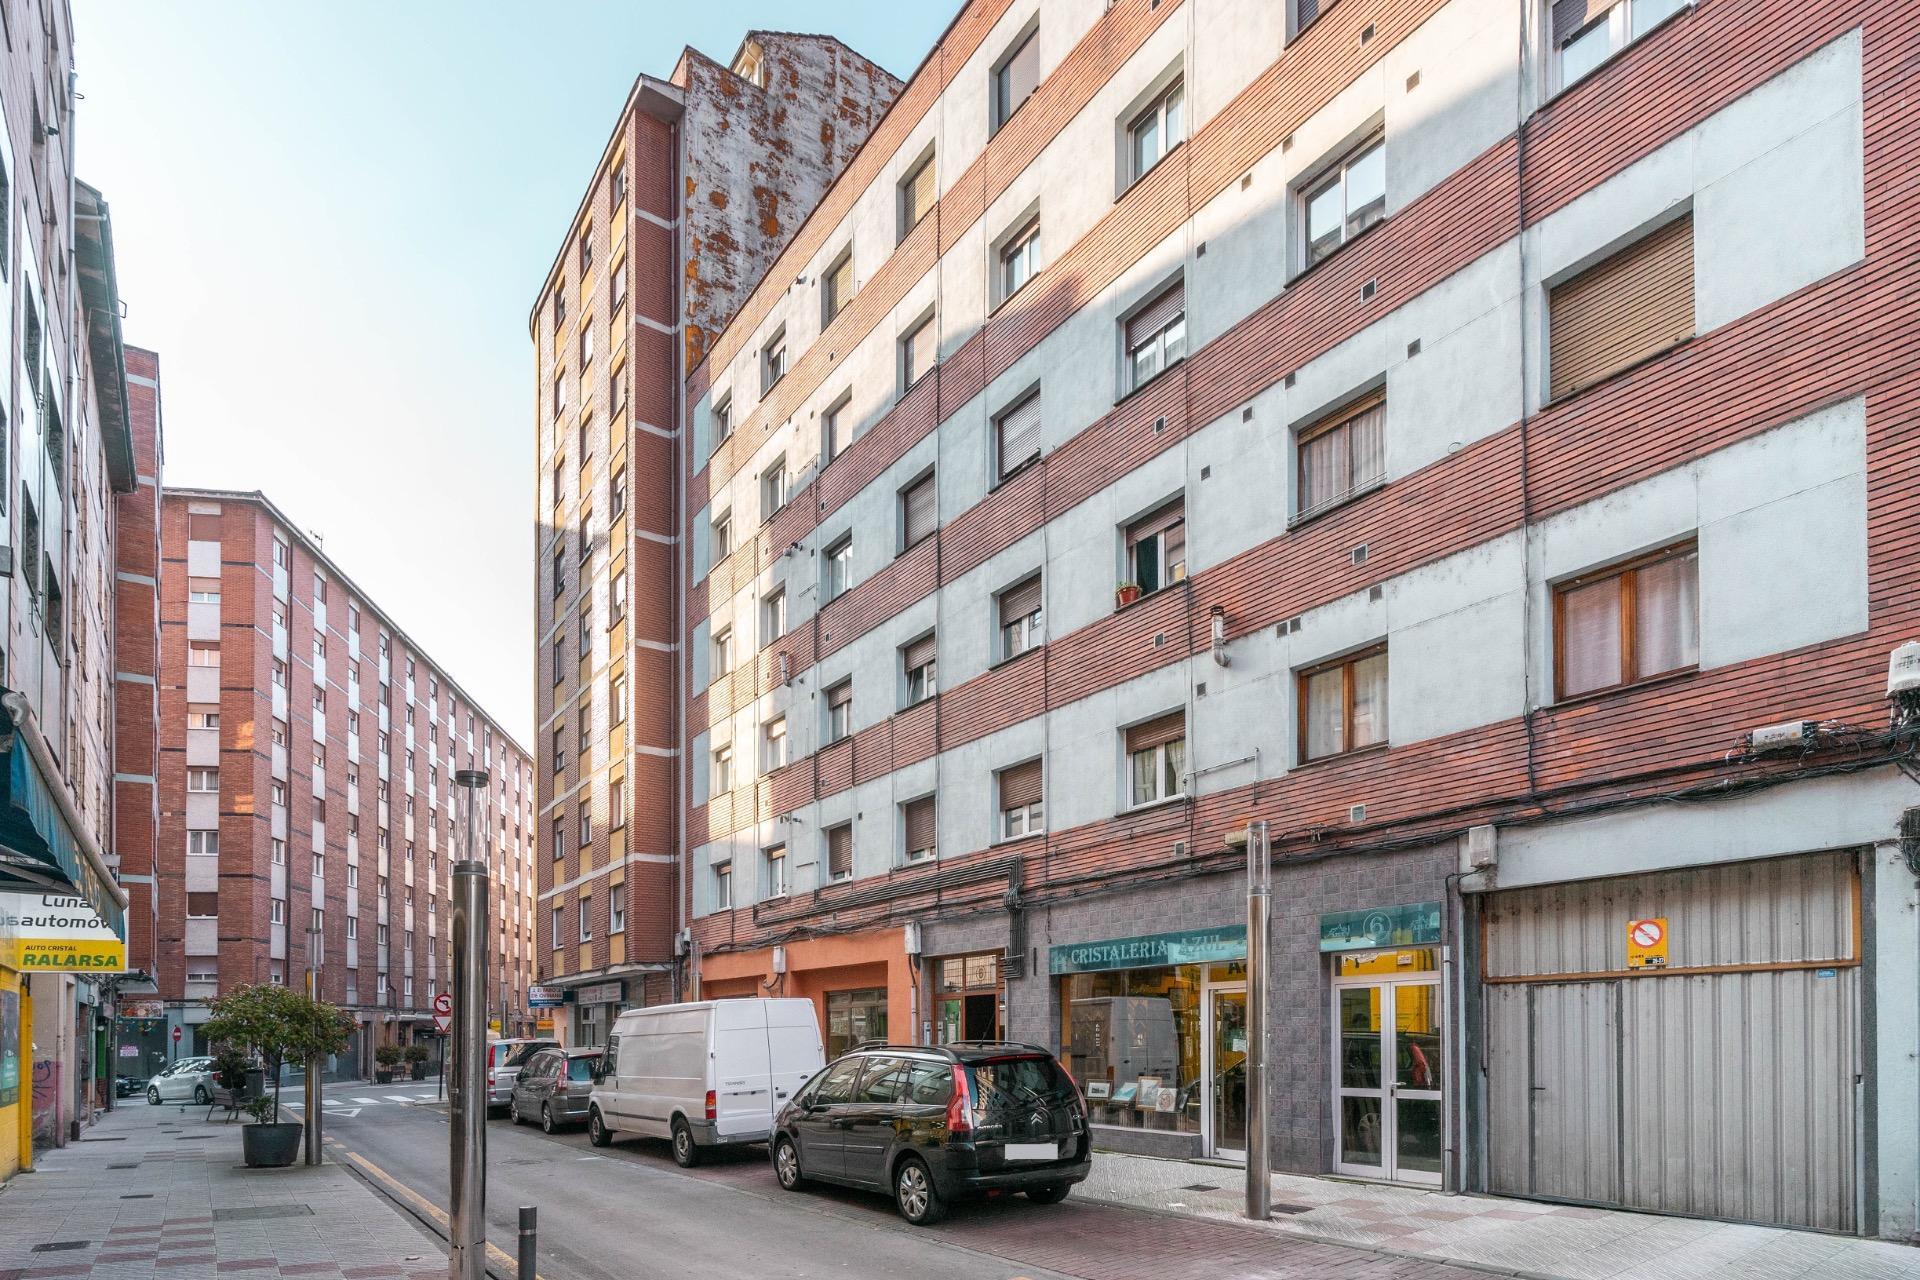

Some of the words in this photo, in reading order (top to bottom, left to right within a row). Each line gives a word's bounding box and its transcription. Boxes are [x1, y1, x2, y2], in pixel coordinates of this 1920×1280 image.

[42, 895, 92, 909] Luna
[21, 914, 110, 929] automóv
[1370, 916, 1384, 938] 6
[1071, 940, 1169, 965] CRISTALERIA
[1179, 934, 1225, 956] AZUL
[23, 954, 118, 967] RALARSA
